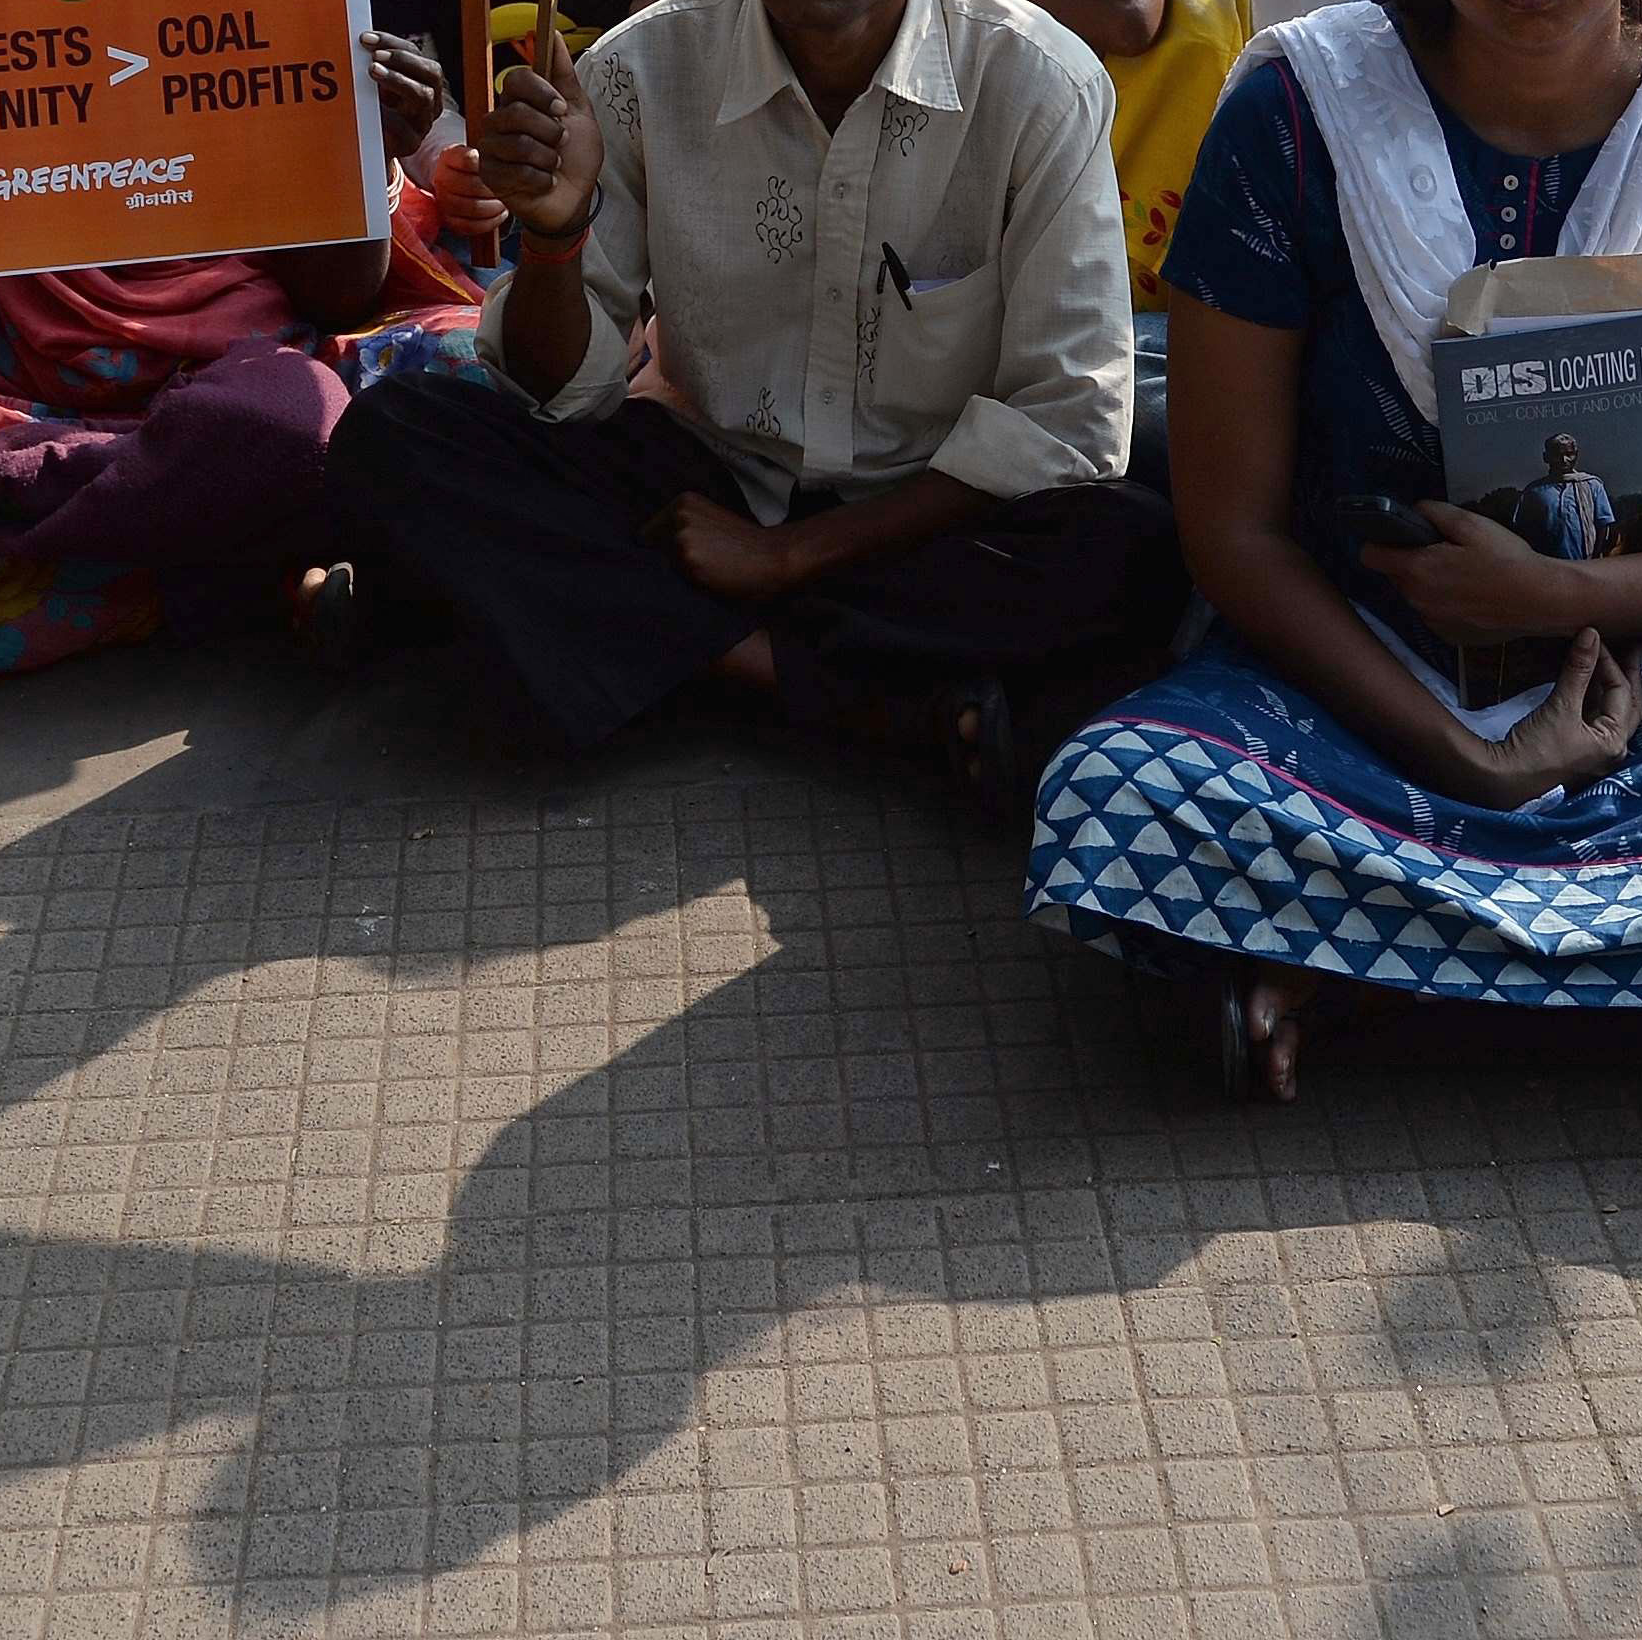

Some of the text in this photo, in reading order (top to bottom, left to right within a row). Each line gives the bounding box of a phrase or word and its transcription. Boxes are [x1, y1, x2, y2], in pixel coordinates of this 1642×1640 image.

[157, 10, 269, 59] COAL
[161, 59, 339, 115] PROFITS
[125, 189, 195, 209] ग्रीनपीस
[1466, 409, 1500, 426] COAL
[1515, 401, 1578, 422] CONFLICT
[1582, 397, 1610, 413] AND
